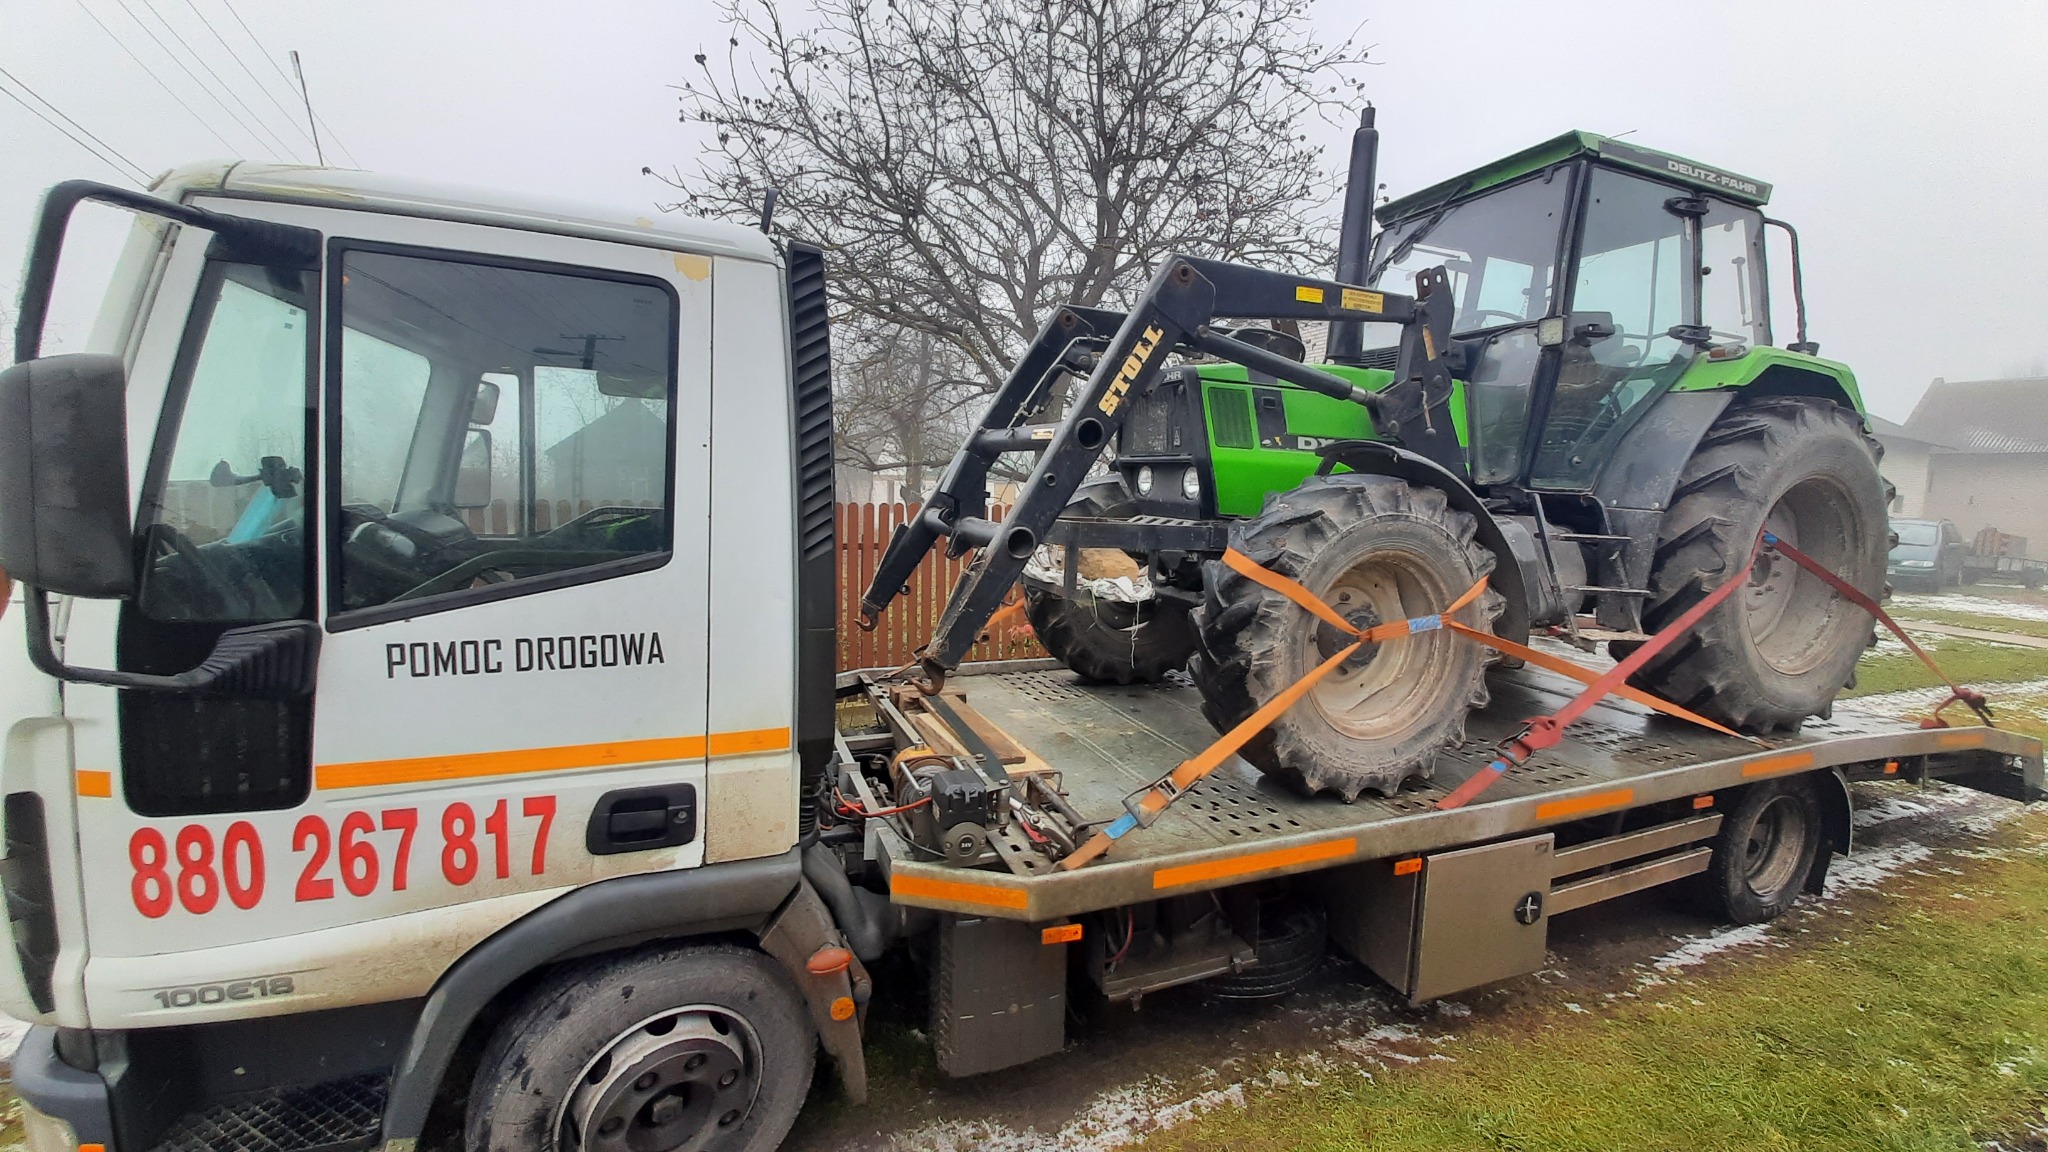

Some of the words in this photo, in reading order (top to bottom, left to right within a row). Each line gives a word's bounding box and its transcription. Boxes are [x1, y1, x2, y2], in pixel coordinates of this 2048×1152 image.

[1098, 324, 1164, 417] STOLL
[386, 639, 502, 679] POMOC
[515, 632, 665, 672] DROGOWA
[129, 820, 265, 919] 880
[292, 808, 418, 902] 267
[441, 795, 557, 886] 817
[154, 976, 295, 1008] 100E18
